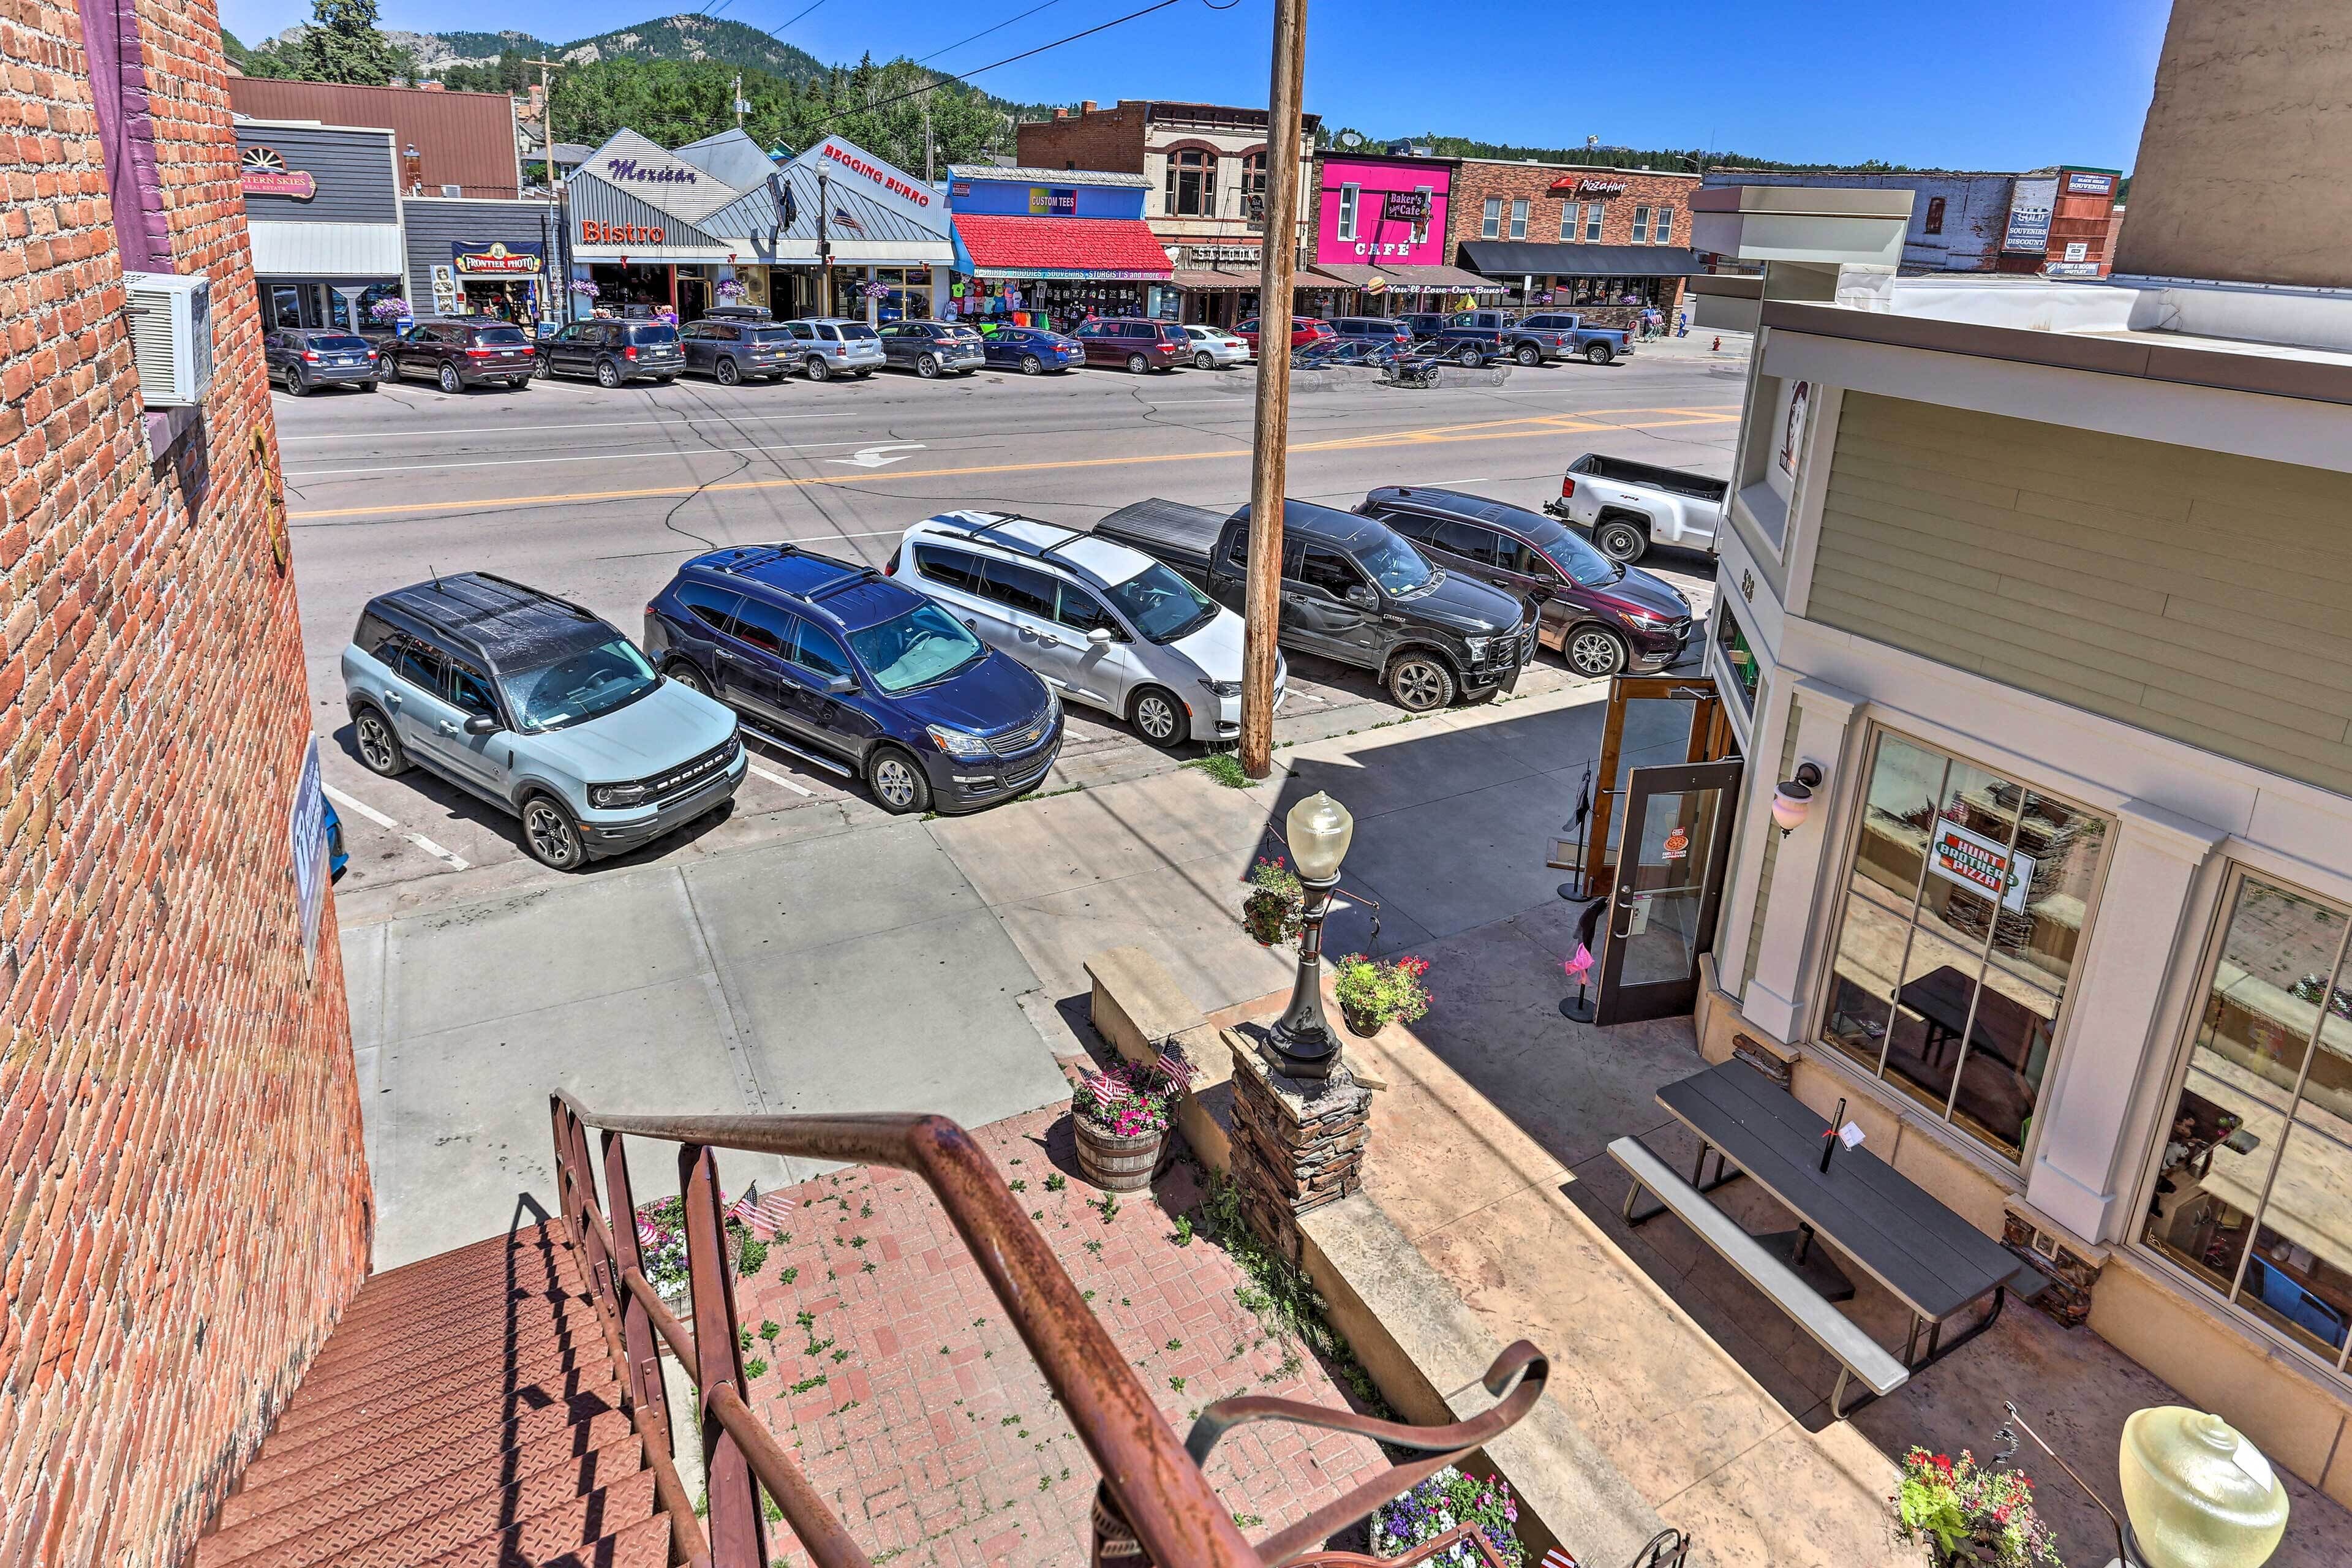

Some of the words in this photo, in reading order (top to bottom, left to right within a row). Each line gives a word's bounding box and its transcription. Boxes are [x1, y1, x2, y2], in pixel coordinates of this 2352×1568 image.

[608, 159, 696, 184] Mexican
[824, 144, 883, 183] BEGGING
[885, 176, 930, 207] BURRO
[241, 176, 274, 184] STERN
[1580, 179, 1607, 191] Pizza
[1606, 181, 1629, 193] Hut
[1031, 196, 1057, 206] CUSTOM
[1059, 197, 1074, 207] TEES
[1391, 194, 1422, 205] Baker's
[1400, 205, 1420, 215] Cafe
[582, 220, 665, 243] Bistro
[1198, 248, 1255, 261] SALOON
[466, 257, 506, 270] FRONTIER
[507, 257, 533, 270] PHOTO
[1387, 285, 1420, 294] You'll
[1422, 285, 1448, 294] Love
[1451, 285, 1471, 295] Our
[1474, 285, 1505, 295] Buns!
[657, 754, 723, 790] BRONCO
[1957, 840, 2000, 867] HUNT
[1953, 859, 1996, 888] PIZZA
